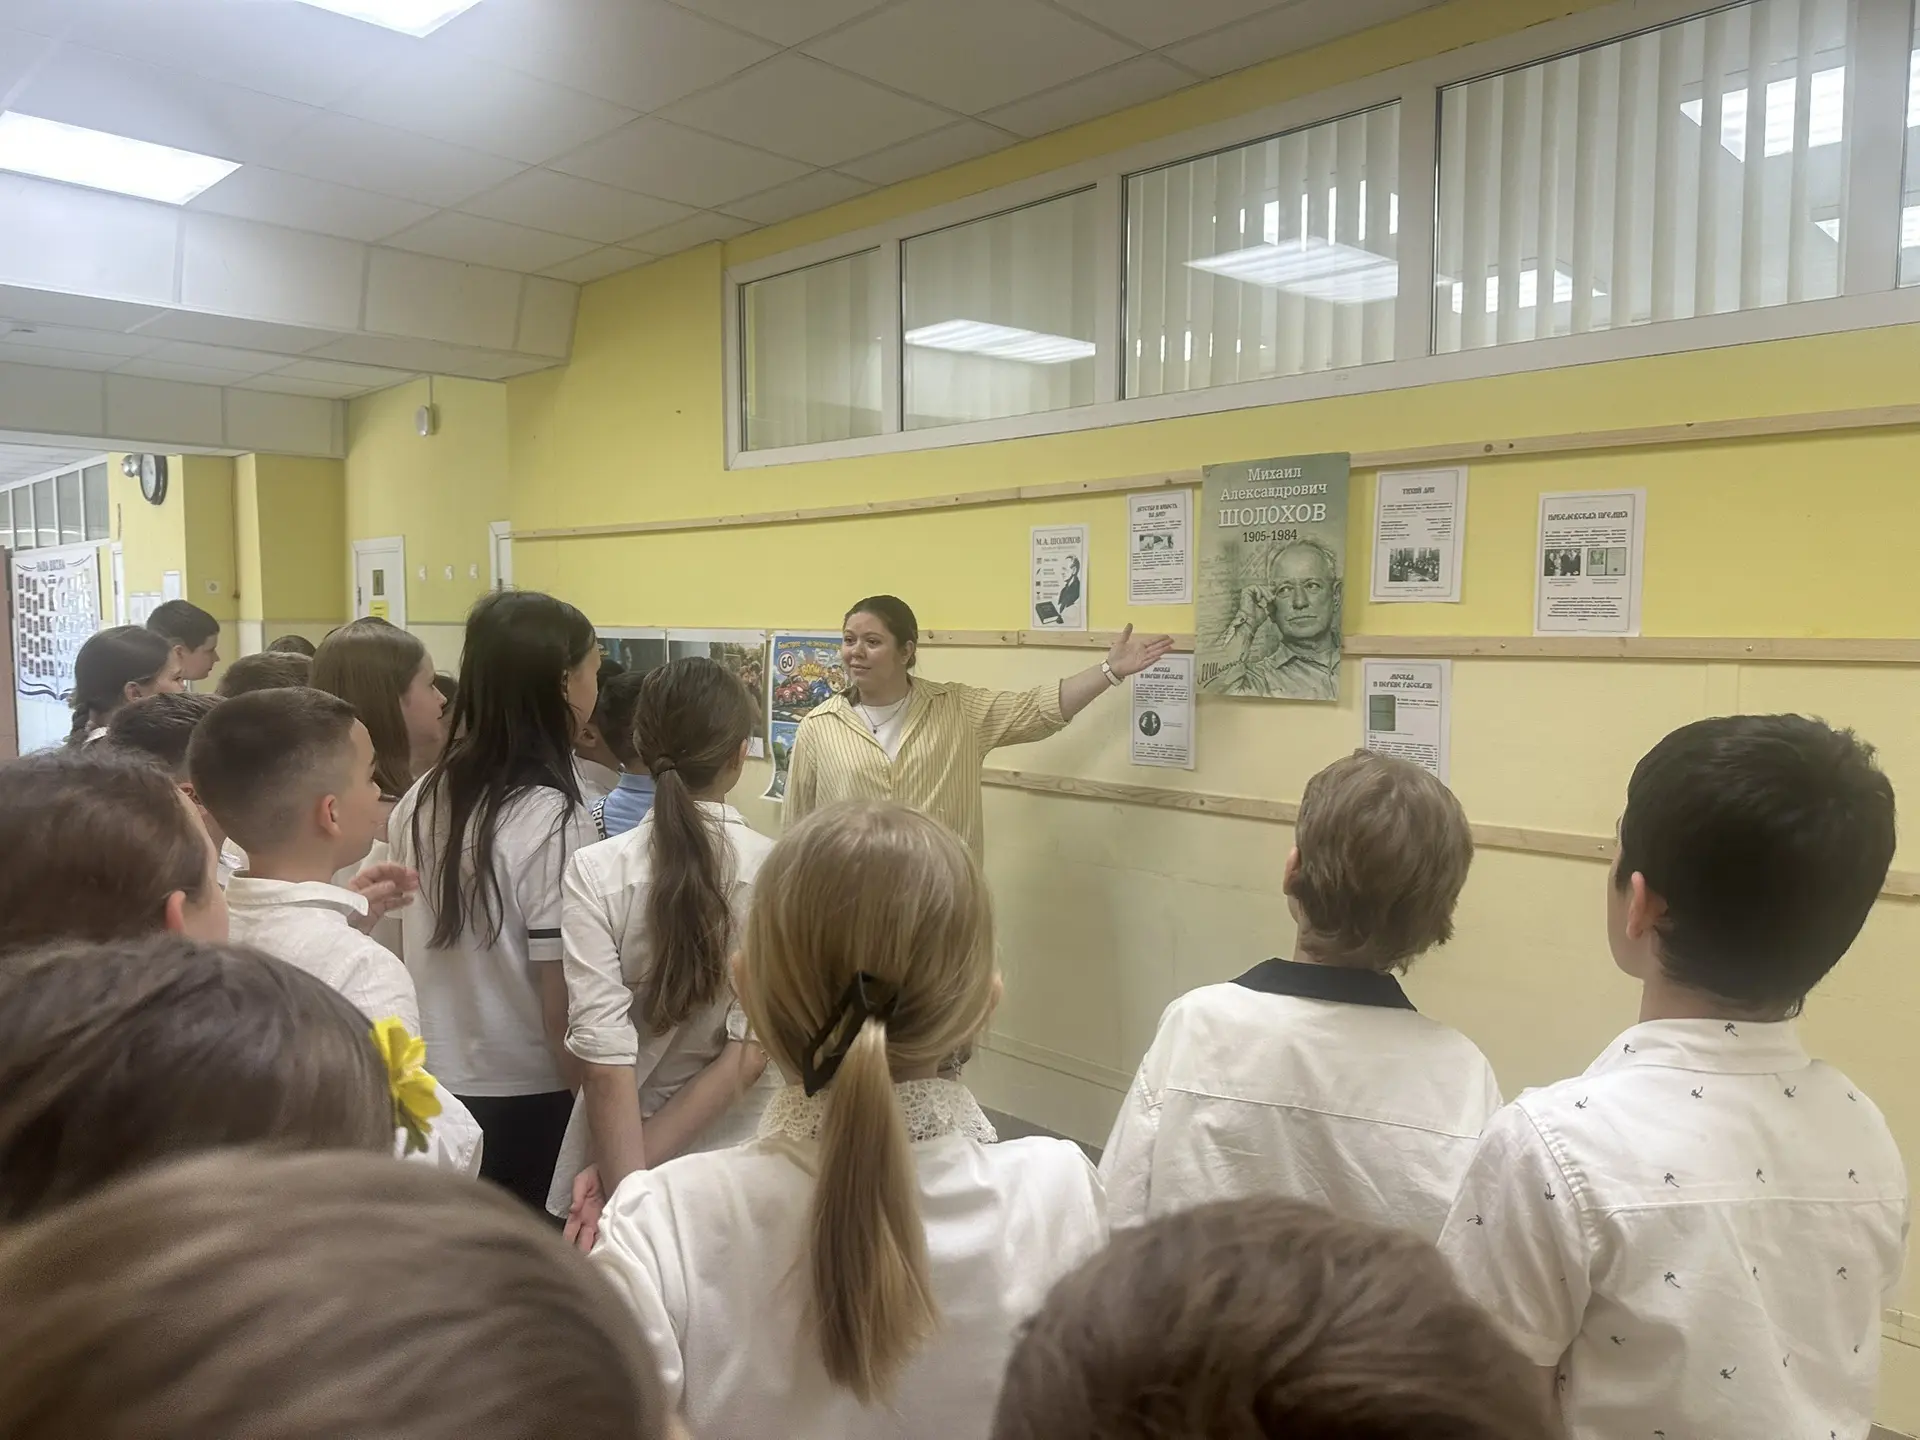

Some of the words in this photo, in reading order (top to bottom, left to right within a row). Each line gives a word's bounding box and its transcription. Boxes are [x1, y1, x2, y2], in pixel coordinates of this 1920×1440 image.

[1248, 467, 1302, 481] Михаил
[1220, 483, 1328, 501] Александрович
[1218, 503, 1327, 528] ШОЛОХОВ
[1050, 536, 1081, 545] ШОЛОХОВ
[1243, 529, 1298, 542] 1905-1984
[781, 656, 793, 669] 60
